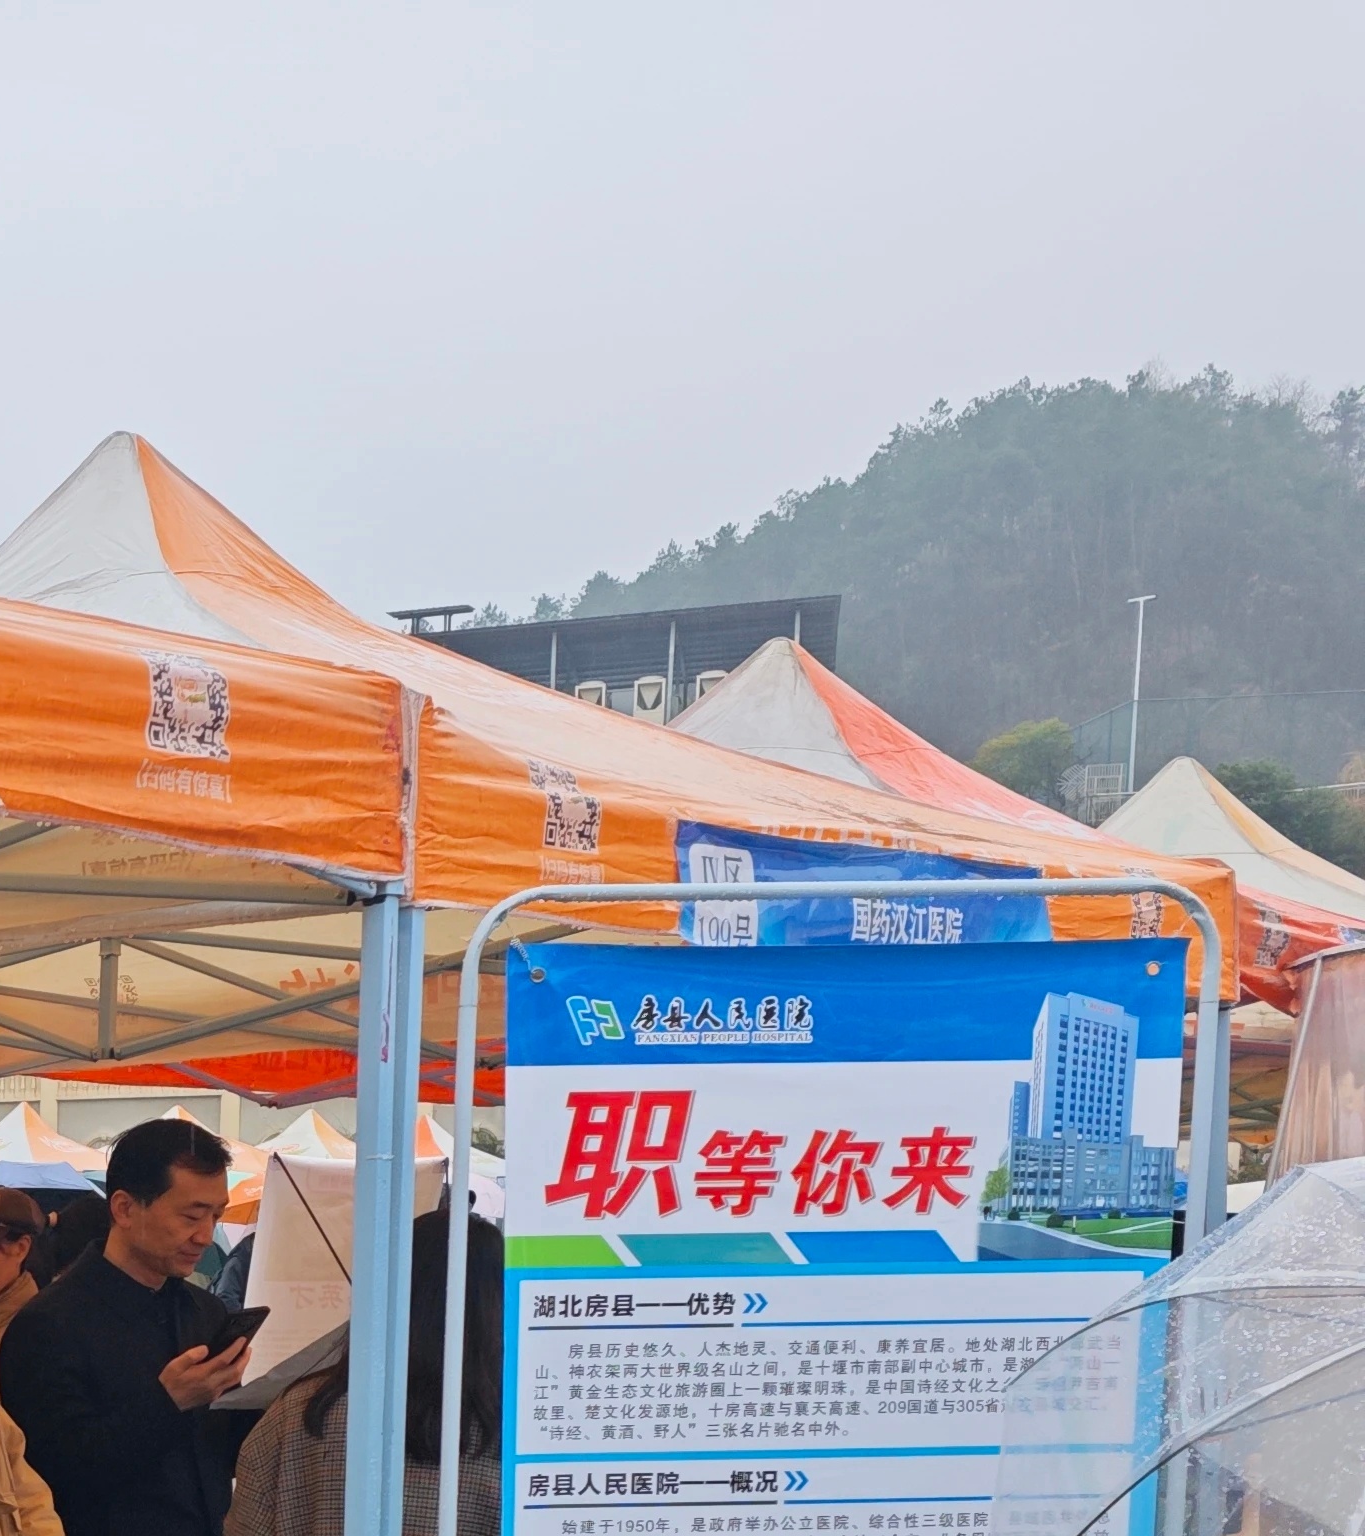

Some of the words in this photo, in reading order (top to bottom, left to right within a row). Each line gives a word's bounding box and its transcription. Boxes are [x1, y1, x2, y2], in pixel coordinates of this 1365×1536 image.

[850, 898, 964, 945] 国药汉江医院
[632, 995, 813, 1029] 房县人民医院
[636, 1033, 698, 1045] FANGXIAN
[703, 1032, 749, 1043] PEOPLE
[753, 1031, 812, 1043] HOSPITAL
[545, 1089, 977, 1220] 职等你来
[528, 1470, 778, 1497] 房县人民医院——概况
